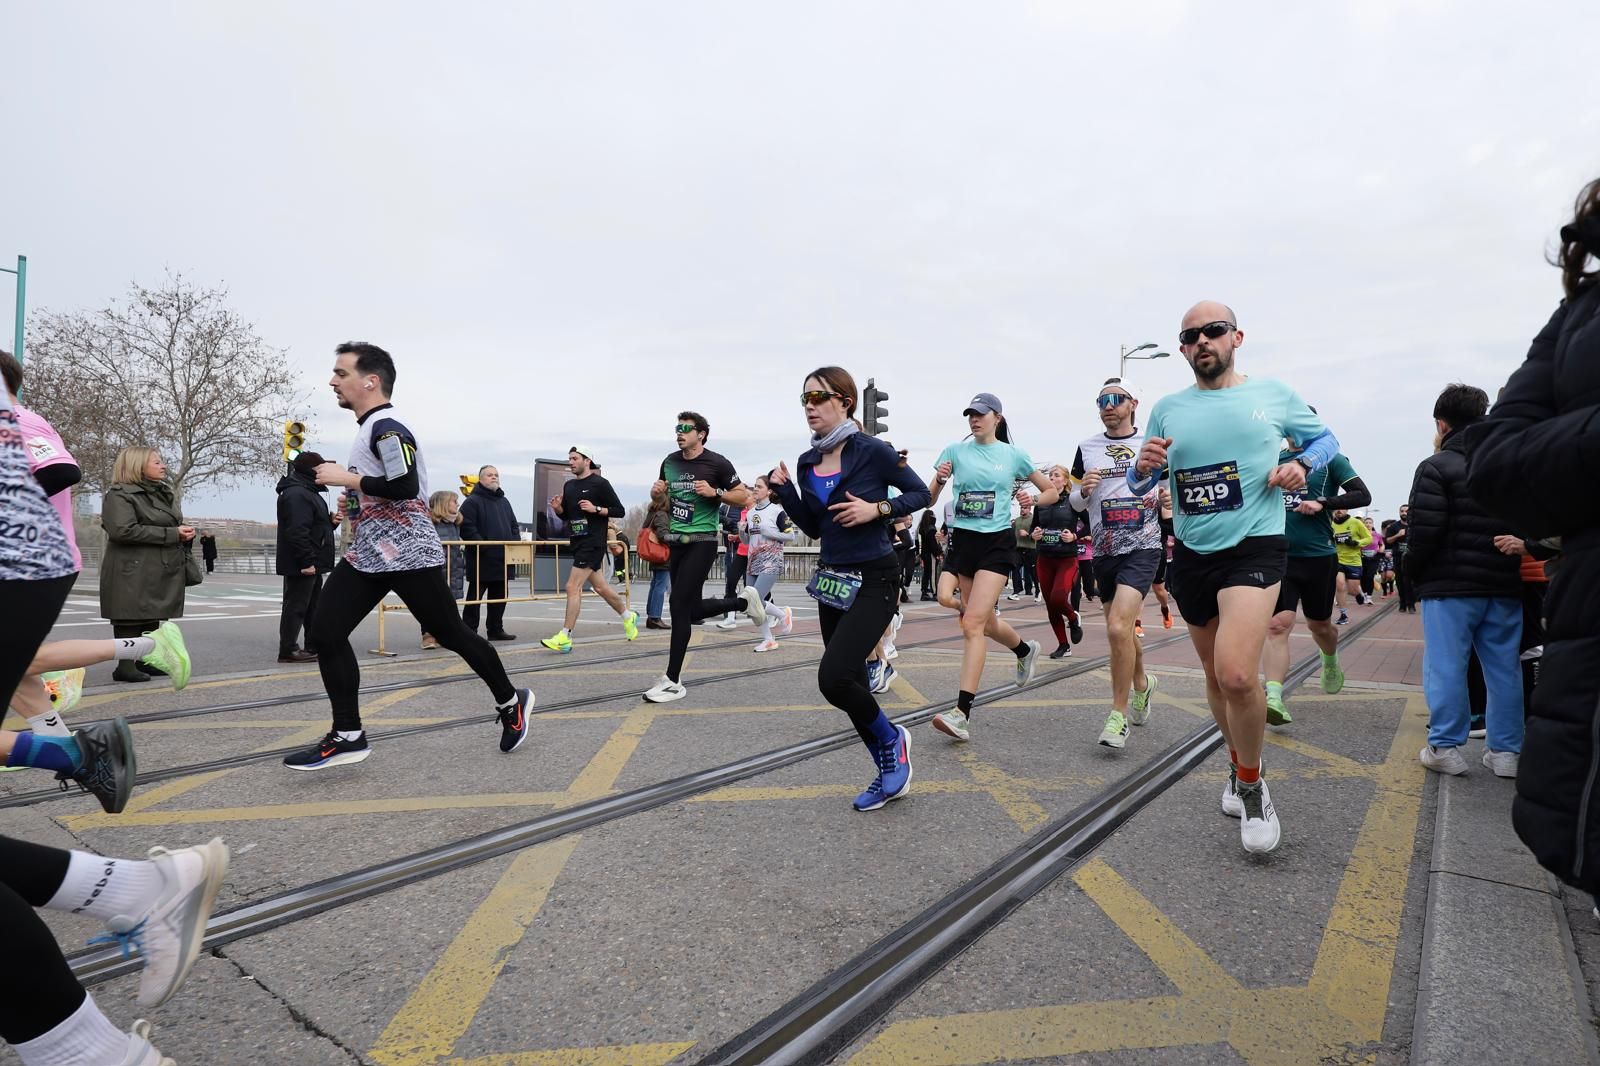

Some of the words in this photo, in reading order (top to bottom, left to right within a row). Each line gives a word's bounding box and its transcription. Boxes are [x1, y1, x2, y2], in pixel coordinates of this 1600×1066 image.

[1183, 483, 1229, 503] 2219
[962, 501, 987, 510] 1491
[672, 506, 689, 518] 2101
[1106, 509, 1140, 521] 3558
[816, 576, 852, 599] 10115
